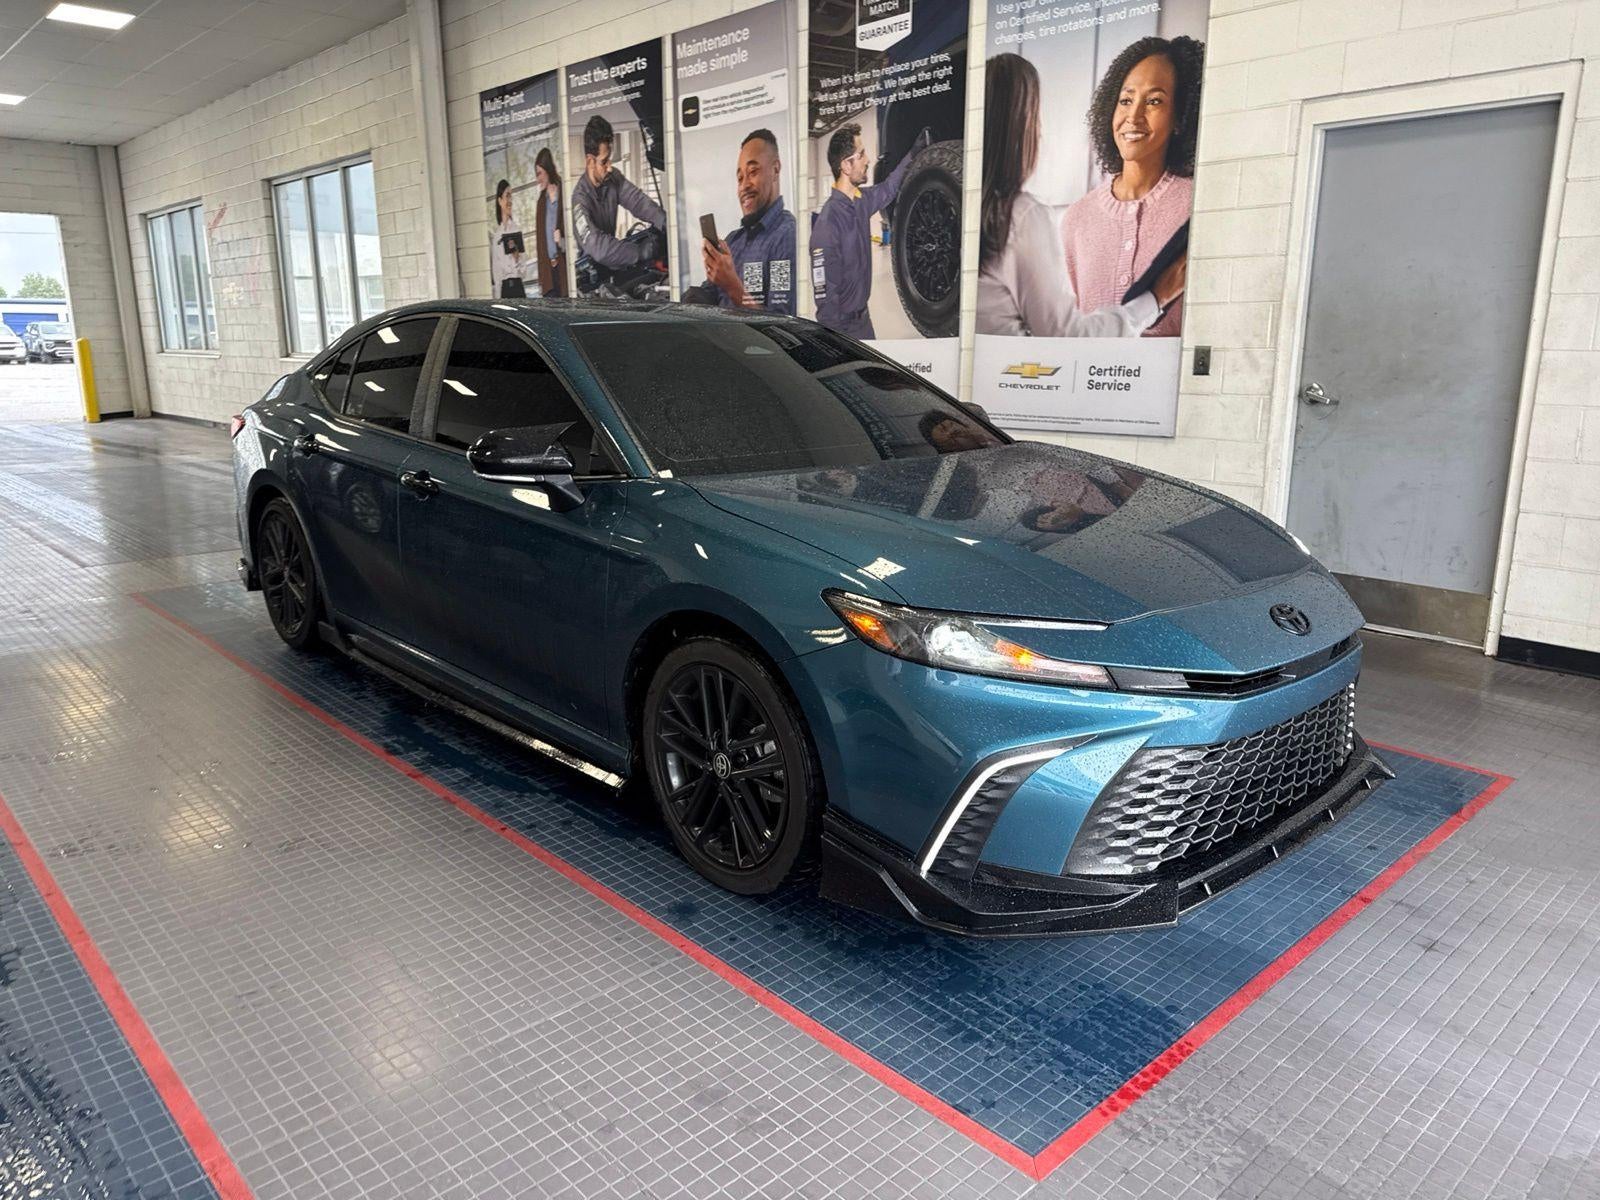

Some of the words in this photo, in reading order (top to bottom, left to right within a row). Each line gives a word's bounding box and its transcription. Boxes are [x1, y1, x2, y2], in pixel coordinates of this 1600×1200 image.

[869, 0, 899, 16] MATCH
[995, 3, 1014, 14] Use
[1014, 0, 1037, 13] your
[994, 30, 1037, 45] changes,
[1039, 25, 1056, 37] tire
[1057, 15, 1104, 34] rotations
[1106, 7, 1127, 23] and
[1129, 3, 1161, 18] more.
[995, 21, 1008, 30] on
[1009, 8, 1051, 27] Certified
[859, 20, 910, 41] GUARANTEE
[677, 28, 750, 59] Maintenance
[569, 70, 592, 88] Trust
[593, 66, 609, 82] the
[610, 57, 648, 78] experts
[677, 58, 708, 79] made
[709, 47, 749, 71] simple
[820, 77, 841, 88] When
[842, 74, 853, 83] it's
[854, 71, 871, 81] time
[872, 69, 881, 77] to
[881, 62, 910, 76] replace
[911, 57, 929, 70] your
[930, 53, 951, 64] tires,
[818, 92, 828, 102] let
[829, 92, 838, 101] us
[839, 89, 848, 99] do
[849, 87, 862, 97] the
[862, 82, 883, 94] work.
[884, 78, 898, 89] We
[898, 75, 917, 87] have
[918, 71, 932, 81] the
[932, 65, 953, 79] right
[483, 91, 525, 112] Multi-Point
[819, 105, 836, 116] tires
[836, 102, 847, 113] for
[847, 100, 864, 113] your
[864, 95, 888, 108] Chevy
[888, 92, 897, 103] at
[898, 90, 912, 101] the
[912, 85, 931, 98] best
[931, 80, 952, 94] deal.
[483, 111, 510, 128] Vehicle
[511, 101, 552, 123] Inspection
[905, 362, 932, 373] tified
[1088, 365, 1141, 378] Certified
[998, 382, 1061, 391] CHEVROLET
[1087, 379, 1131, 391] Service
